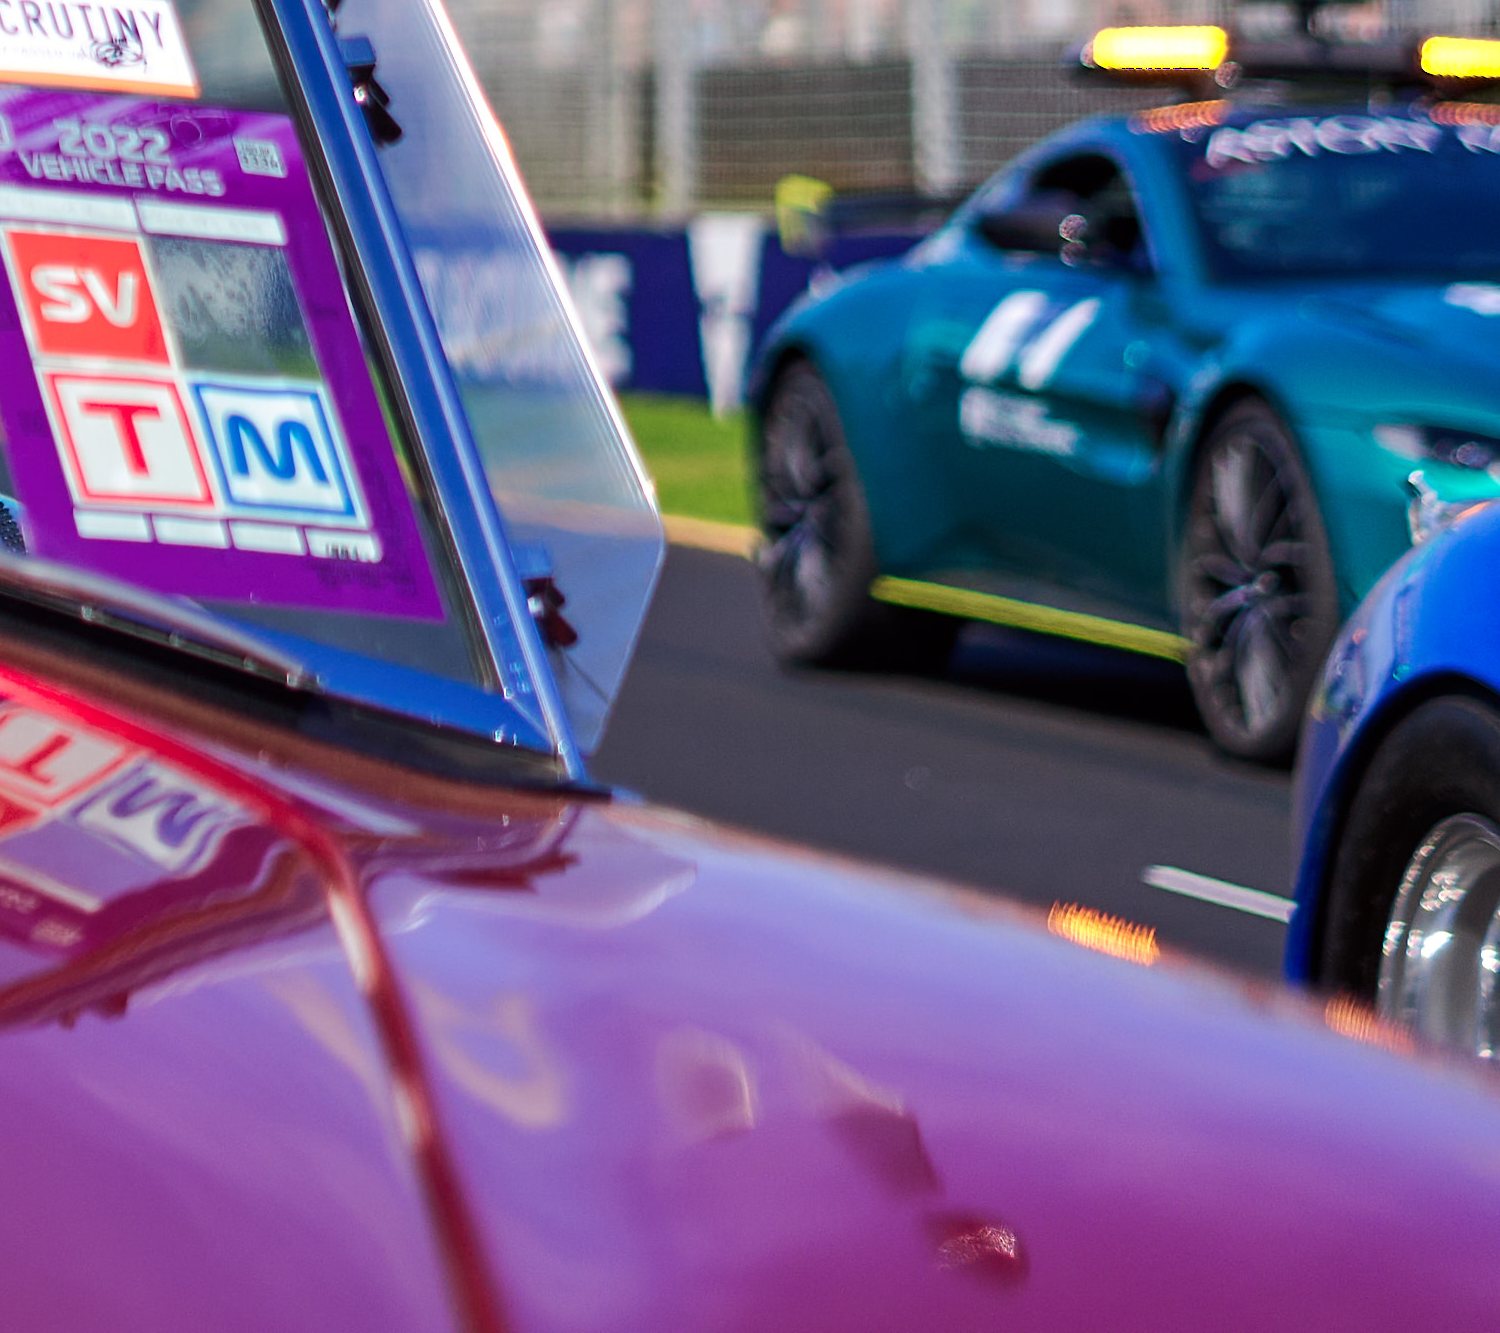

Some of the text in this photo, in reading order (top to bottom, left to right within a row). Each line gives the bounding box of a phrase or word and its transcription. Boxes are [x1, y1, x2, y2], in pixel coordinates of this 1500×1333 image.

[16, 150, 227, 198] VEHICLE PASS
[53, 119, 173, 165] 2022
[30, 263, 138, 329] SV
[78, 400, 162, 478] T
[225, 413, 331, 486] M
